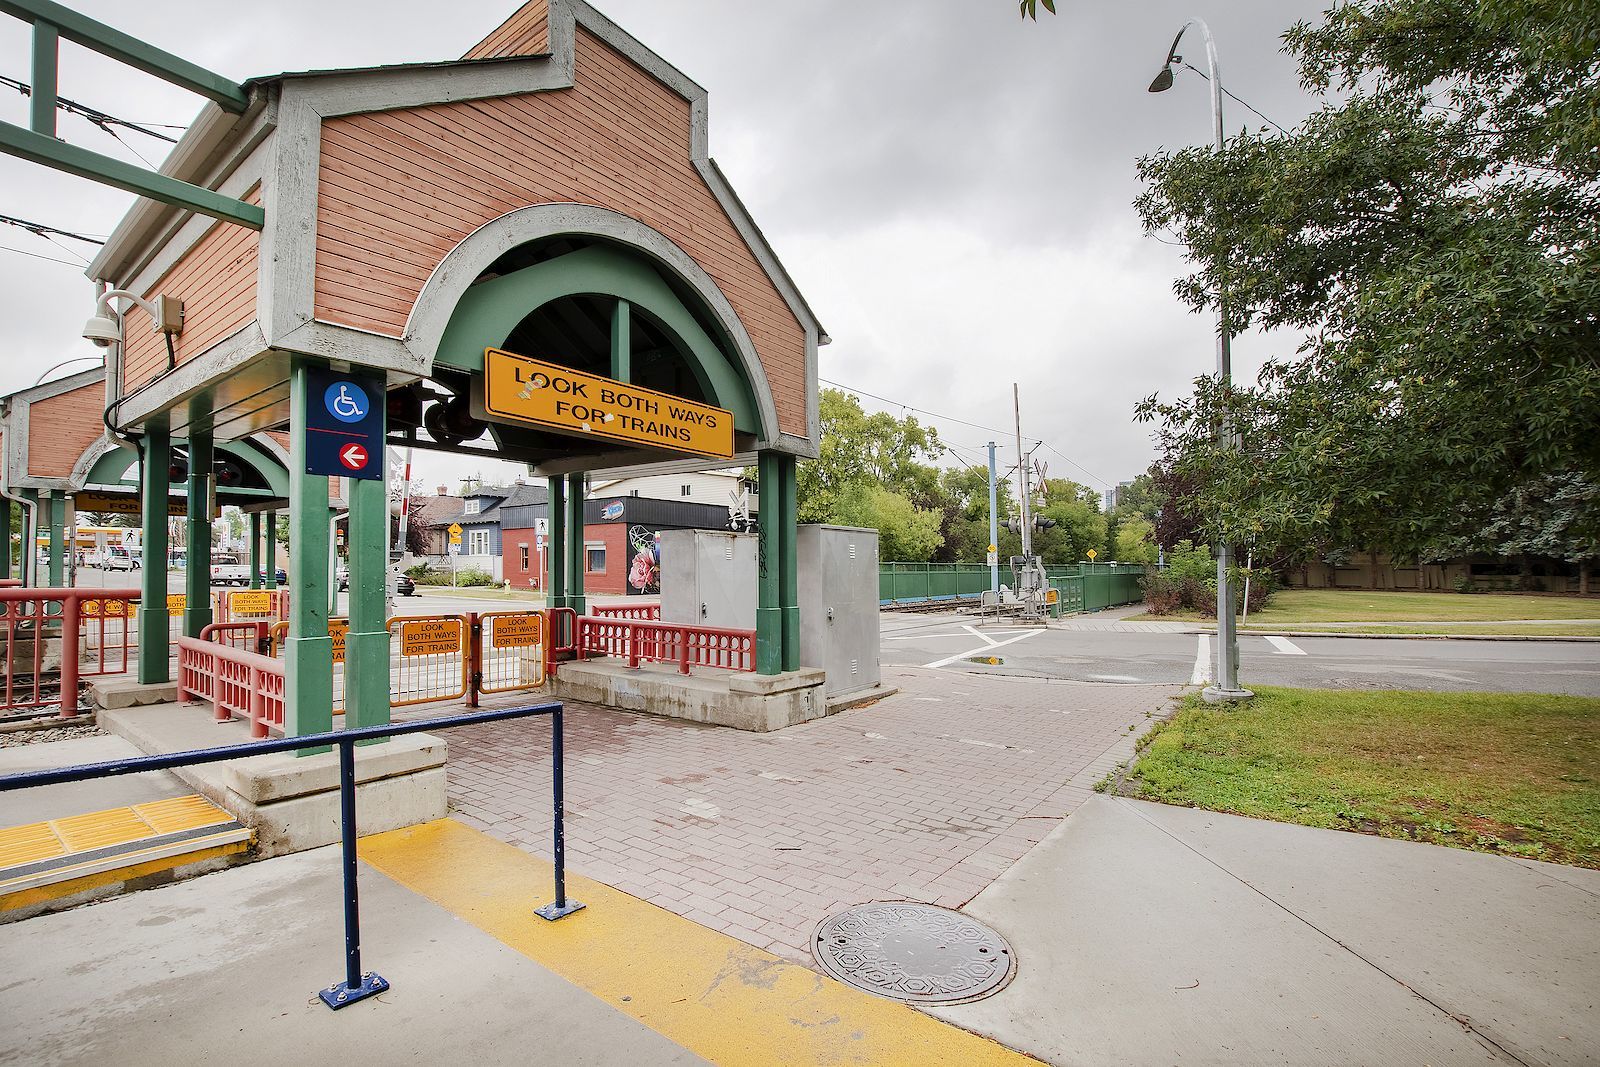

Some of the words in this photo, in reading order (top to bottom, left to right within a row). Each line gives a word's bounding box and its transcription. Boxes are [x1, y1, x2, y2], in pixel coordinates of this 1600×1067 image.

[514, 366, 588, 399] LOOK
[601, 388, 659, 415] BOTH
[668, 405, 718, 428] WAYS
[556, 401, 606, 425] FOR
[617, 413, 692, 442] TRAINS
[508, 618, 528, 626] LOOK
[421, 623, 444, 632] LOOK
[496, 626, 517, 634] BOTH
[407, 633, 431, 641] BOTH
[434, 631, 457, 639] WAYS
[513, 636, 538, 644] TRAINS
[406, 645, 425, 654] FOR
[428, 642, 458, 652] TRAINS
